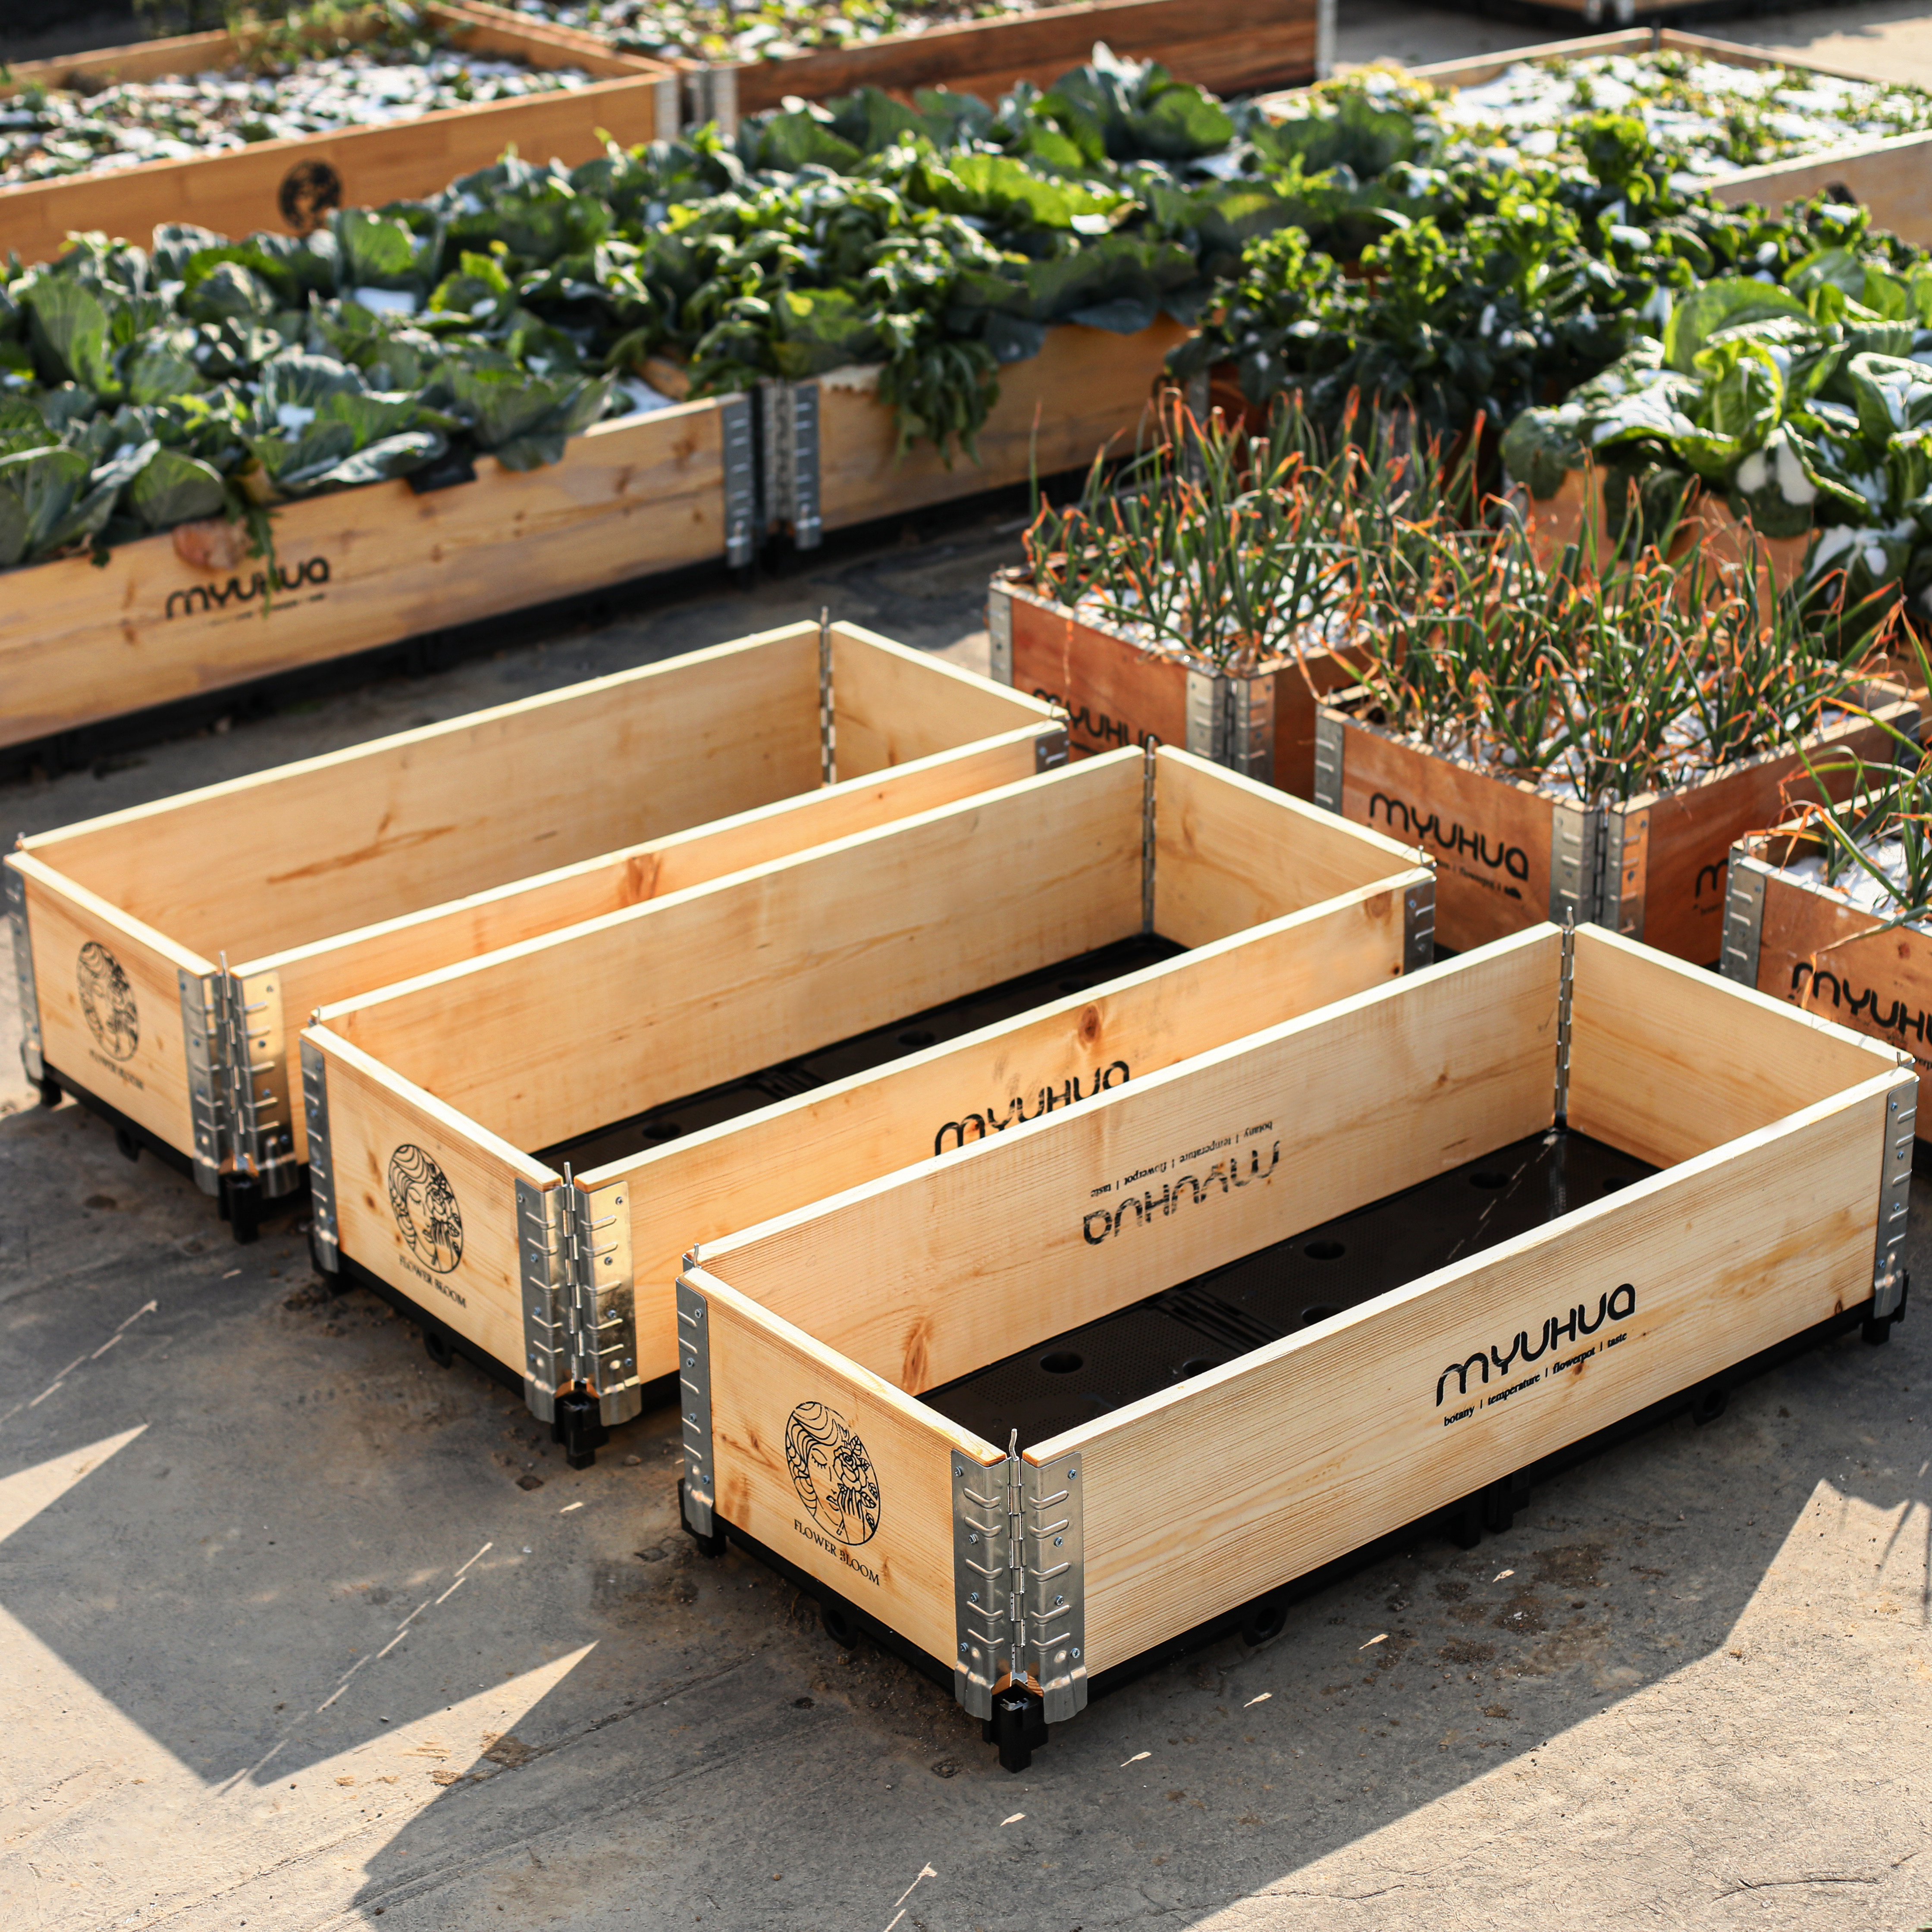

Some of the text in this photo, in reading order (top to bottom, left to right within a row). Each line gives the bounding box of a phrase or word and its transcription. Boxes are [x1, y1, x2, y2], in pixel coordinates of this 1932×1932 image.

[1444, 1405, 1474, 1427] botany
[1488, 1374, 1540, 1405] temperature
[1553, 1347, 1596, 1373] flowerpot
[1607, 1332, 1627, 1348] taste
[794, 1519, 880, 1586] FLOWER BLOOM
